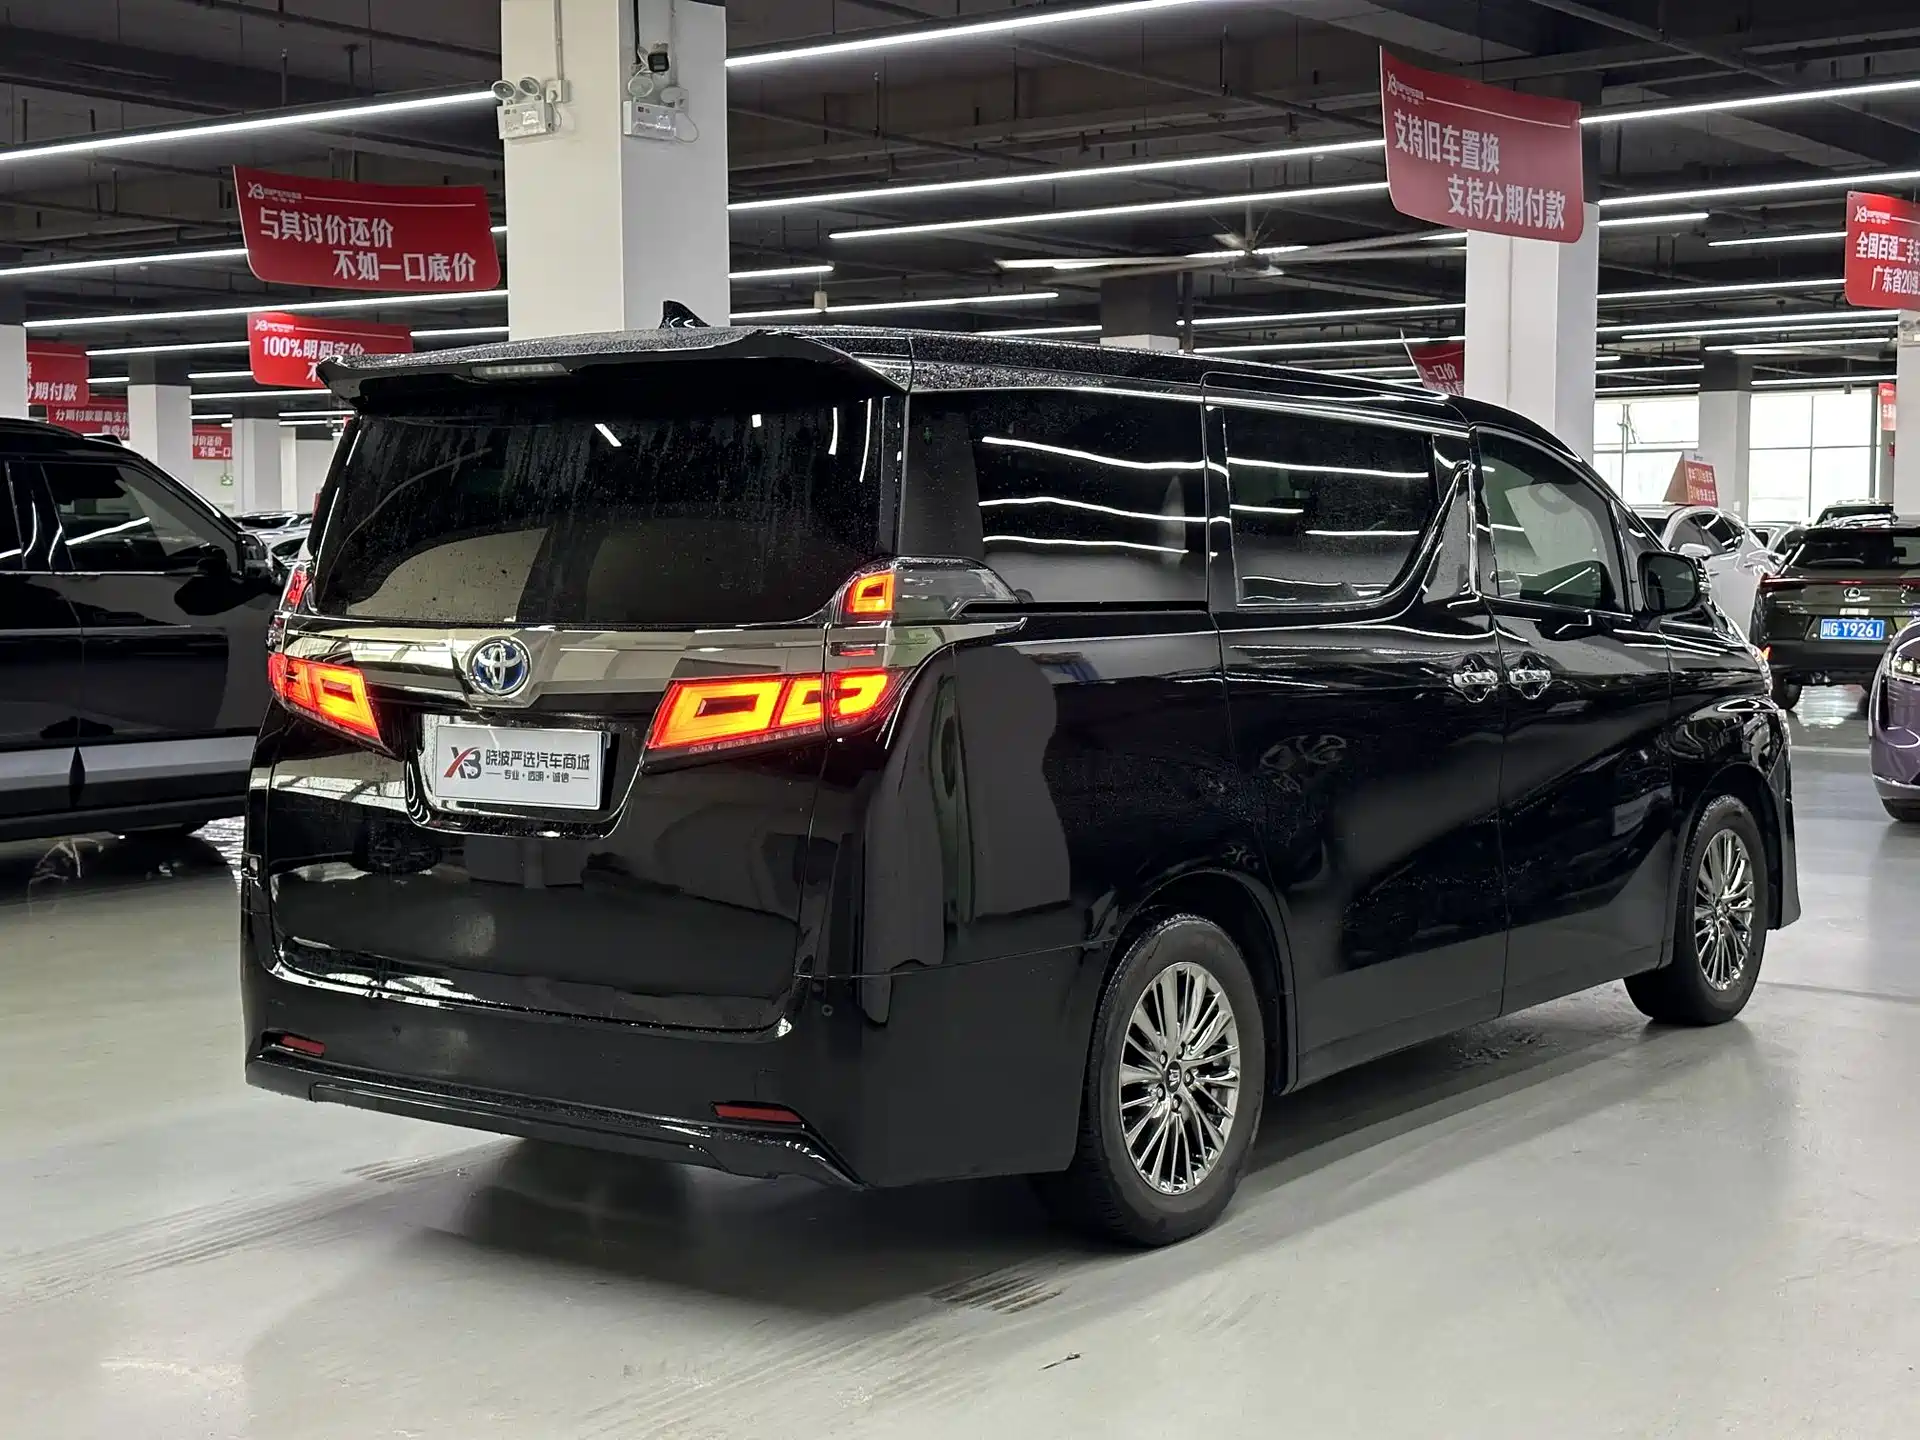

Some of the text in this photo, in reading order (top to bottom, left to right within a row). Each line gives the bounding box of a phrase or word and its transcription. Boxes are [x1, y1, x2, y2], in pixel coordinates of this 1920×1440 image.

[1393, 108, 1500, 175] 支持旧车置换
[1447, 173, 1566, 230] 支持分期付款
[260, 206, 394, 248] 与其讨价还价
[333, 249, 477, 282] 不如一口底价
[1871, 265, 1920, 296] 广东省20强
[263, 335, 366, 360] 100%明码实价
[485, 749, 590, 771] 晓波严选汽车商城
